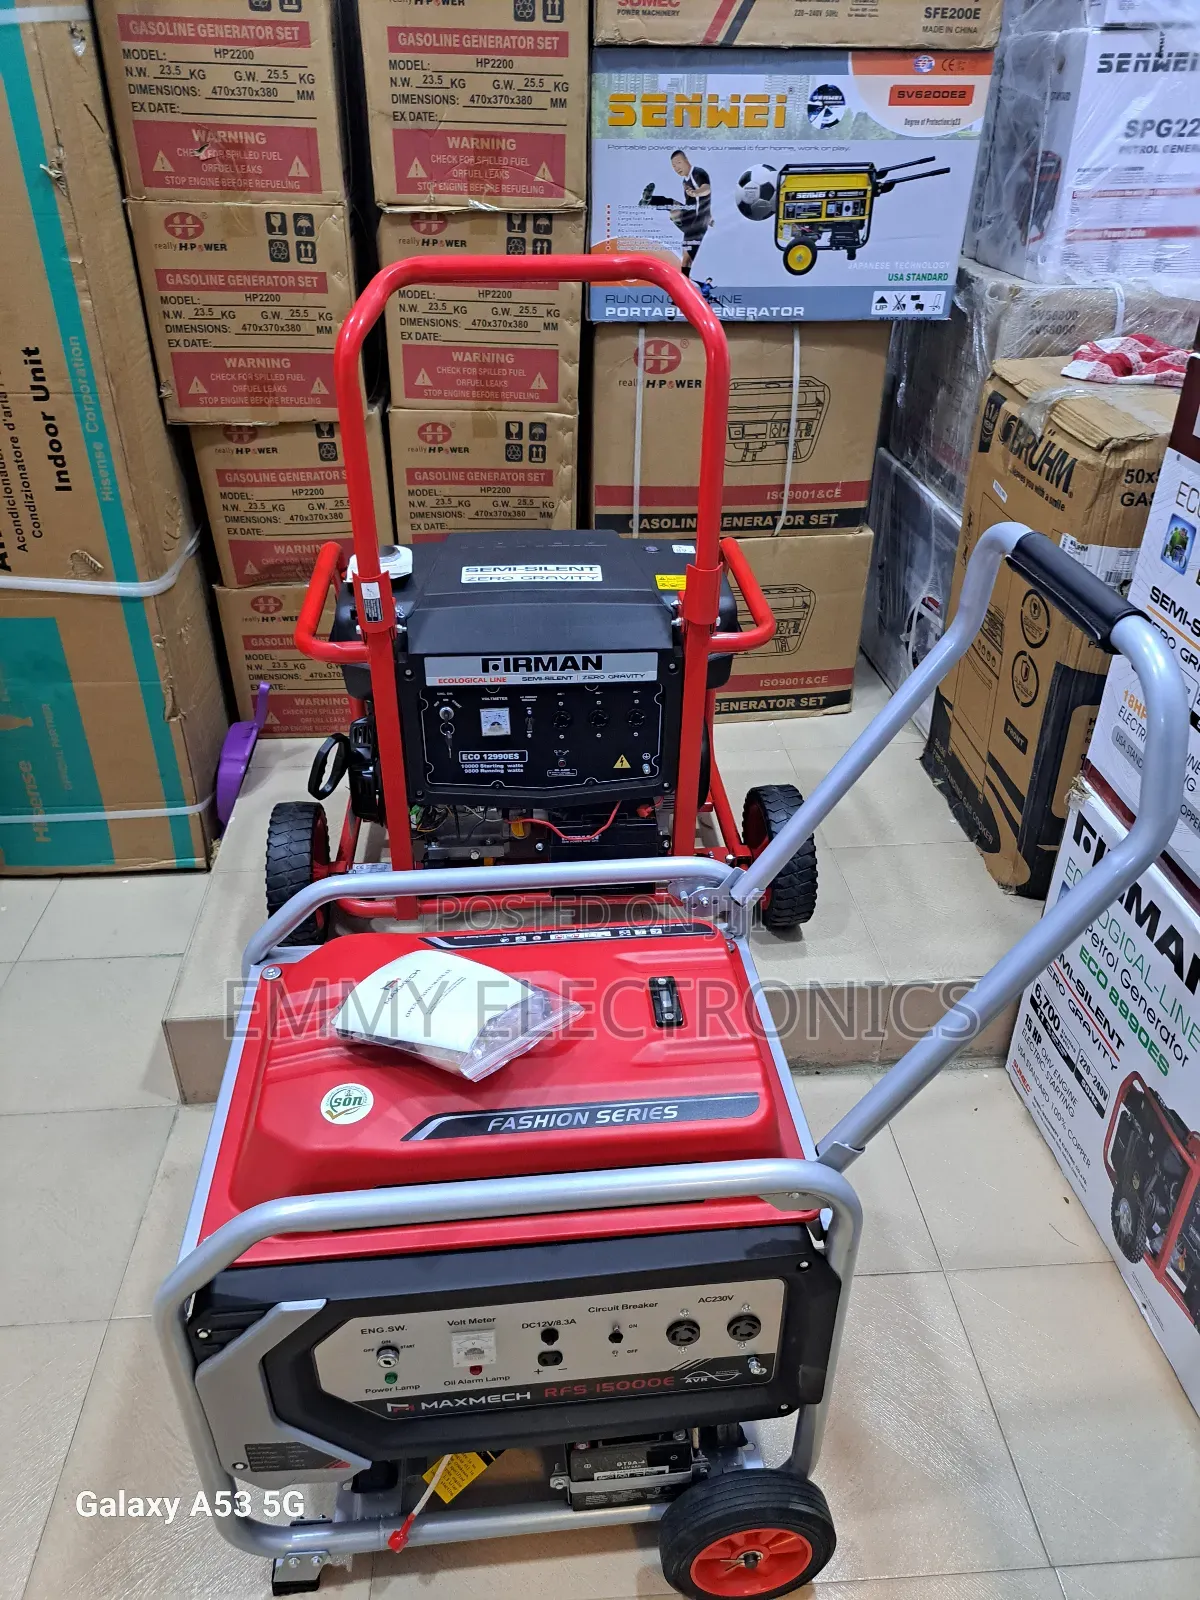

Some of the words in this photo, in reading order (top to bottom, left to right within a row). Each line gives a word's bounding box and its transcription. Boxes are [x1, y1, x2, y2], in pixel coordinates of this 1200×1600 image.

[924, 7, 981, 20] SFE200E
[129, 21, 195, 37] GASOLINE
[198, 25, 274, 39] GENERATOR
[277, 27, 299, 40] SET
[922, 26, 943, 34] MADE
[945, 26, 952, 34] IN
[954, 26, 978, 34] CHINA
[398, 32, 459, 47] GASOLINE
[463, 35, 534, 49] GENERATOR
[537, 37, 559, 50] SET
[389, 60, 430, 71] MODEL:
[476, 58, 513, 69] HP2200
[390, 77, 412, 88] N.W.
[423, 75, 442, 84] 23.5
[451, 78, 466, 88] KG
[493, 79, 515, 90] G.W.
[524, 78, 544, 88] 25.5
[554, 82, 569, 92] KG
[897, 90, 966, 99] SV6200E2
[392, 94, 459, 105] DIMENSIONS:
[470, 95, 532, 105] 470x370x380
[551, 98, 567, 108] MM
[393, 111, 406, 121] EX
[409, 111, 438, 121] DATE:
[607, 93, 788, 128] SENWEI
[447, 137, 516, 150] WARNING
[431, 155, 457, 164] CHECK
[459, 156, 474, 164] FOR
[510, 157, 530, 166] FUEL
[453, 170, 483, 178] ORFUEL
[485, 170, 510, 179] LEAKS
[417, 182, 437, 190] STOP
[439, 183, 467, 191] ENGINE
[501, 185, 544, 194] REFUELING
[848, 262, 890, 270] JAPANESE
[166, 274, 225, 286] GASOLINE
[228, 275, 295, 287] GENERATOR
[298, 276, 318, 287] SET
[906, 273, 948, 281] STANDARD
[160, 296, 200, 305] MODEL:
[245, 294, 280, 302] HP2200
[399, 290, 435, 299] MODEL:
[478, 290, 512, 298] HP2200
[605, 294, 640, 304] RUN
[642, 294, 664, 304] ON
[165, 324, 231, 333] DIMENSIONS:
[241, 324, 301, 332] 470x370x380
[317, 326, 332, 334] MM
[224, 358, 291, 368] WARNING
[21, 346, 50, 402] Unit
[70, 336, 100, 433] Corporation
[48, 412, 72, 492] Indoor
[95, 442, 114, 501] Hisense
[415, 471, 465, 481] GASOLINE
[467, 472, 526, 482] GENERATOR
[528, 473, 545, 481] SET
[10, 436, 43, 539] Condizionatore
[809, 514, 838, 526] SET
[520, 574, 599, 582] GRAVITY
[481, 655, 603, 673] FIRMAN
[760, 676, 828, 687] ISO9001&CE
[800, 696, 826, 706] SET
[1006, 724, 1025, 746] FRONT
[1116, 732, 1128, 751] USA
[1079, 944, 1108, 990] ECO
[1108, 986, 1170, 1076] 8990ES
[1120, 968, 1189, 1067] Generator
[1068, 999, 1118, 1070] GRAVITY
[1021, 1028, 1046, 1072] ELECTRIC
[1045, 1071, 1075, 1118] STARTING
[1041, 1048, 1054, 1069] OHV
[1052, 1070, 1078, 1106] ENGINE
[487, 1112, 589, 1132] FASHION
[595, 1106, 678, 1124] SERIES
[1025, 1060, 1050, 1102] STANDARD
[1068, 1129, 1091, 1168] COPPER
[698, 1295, 734, 1304] AC230V
[588, 1304, 620, 1313] Circuit
[622, 1301, 658, 1311] Breaker
[447, 1318, 471, 1326] Volt
[522, 1318, 577, 1329] DC12V/8.3A
[360, 1324, 408, 1335] ENG.SW.
[459, 1377, 483, 1385] Alarm
[486, 1375, 510, 1383] Lamp
[365, 1386, 393, 1394] Power
[396, 1384, 420, 1392] Lamp
[421, 1390, 531, 1410] MAXMECH
